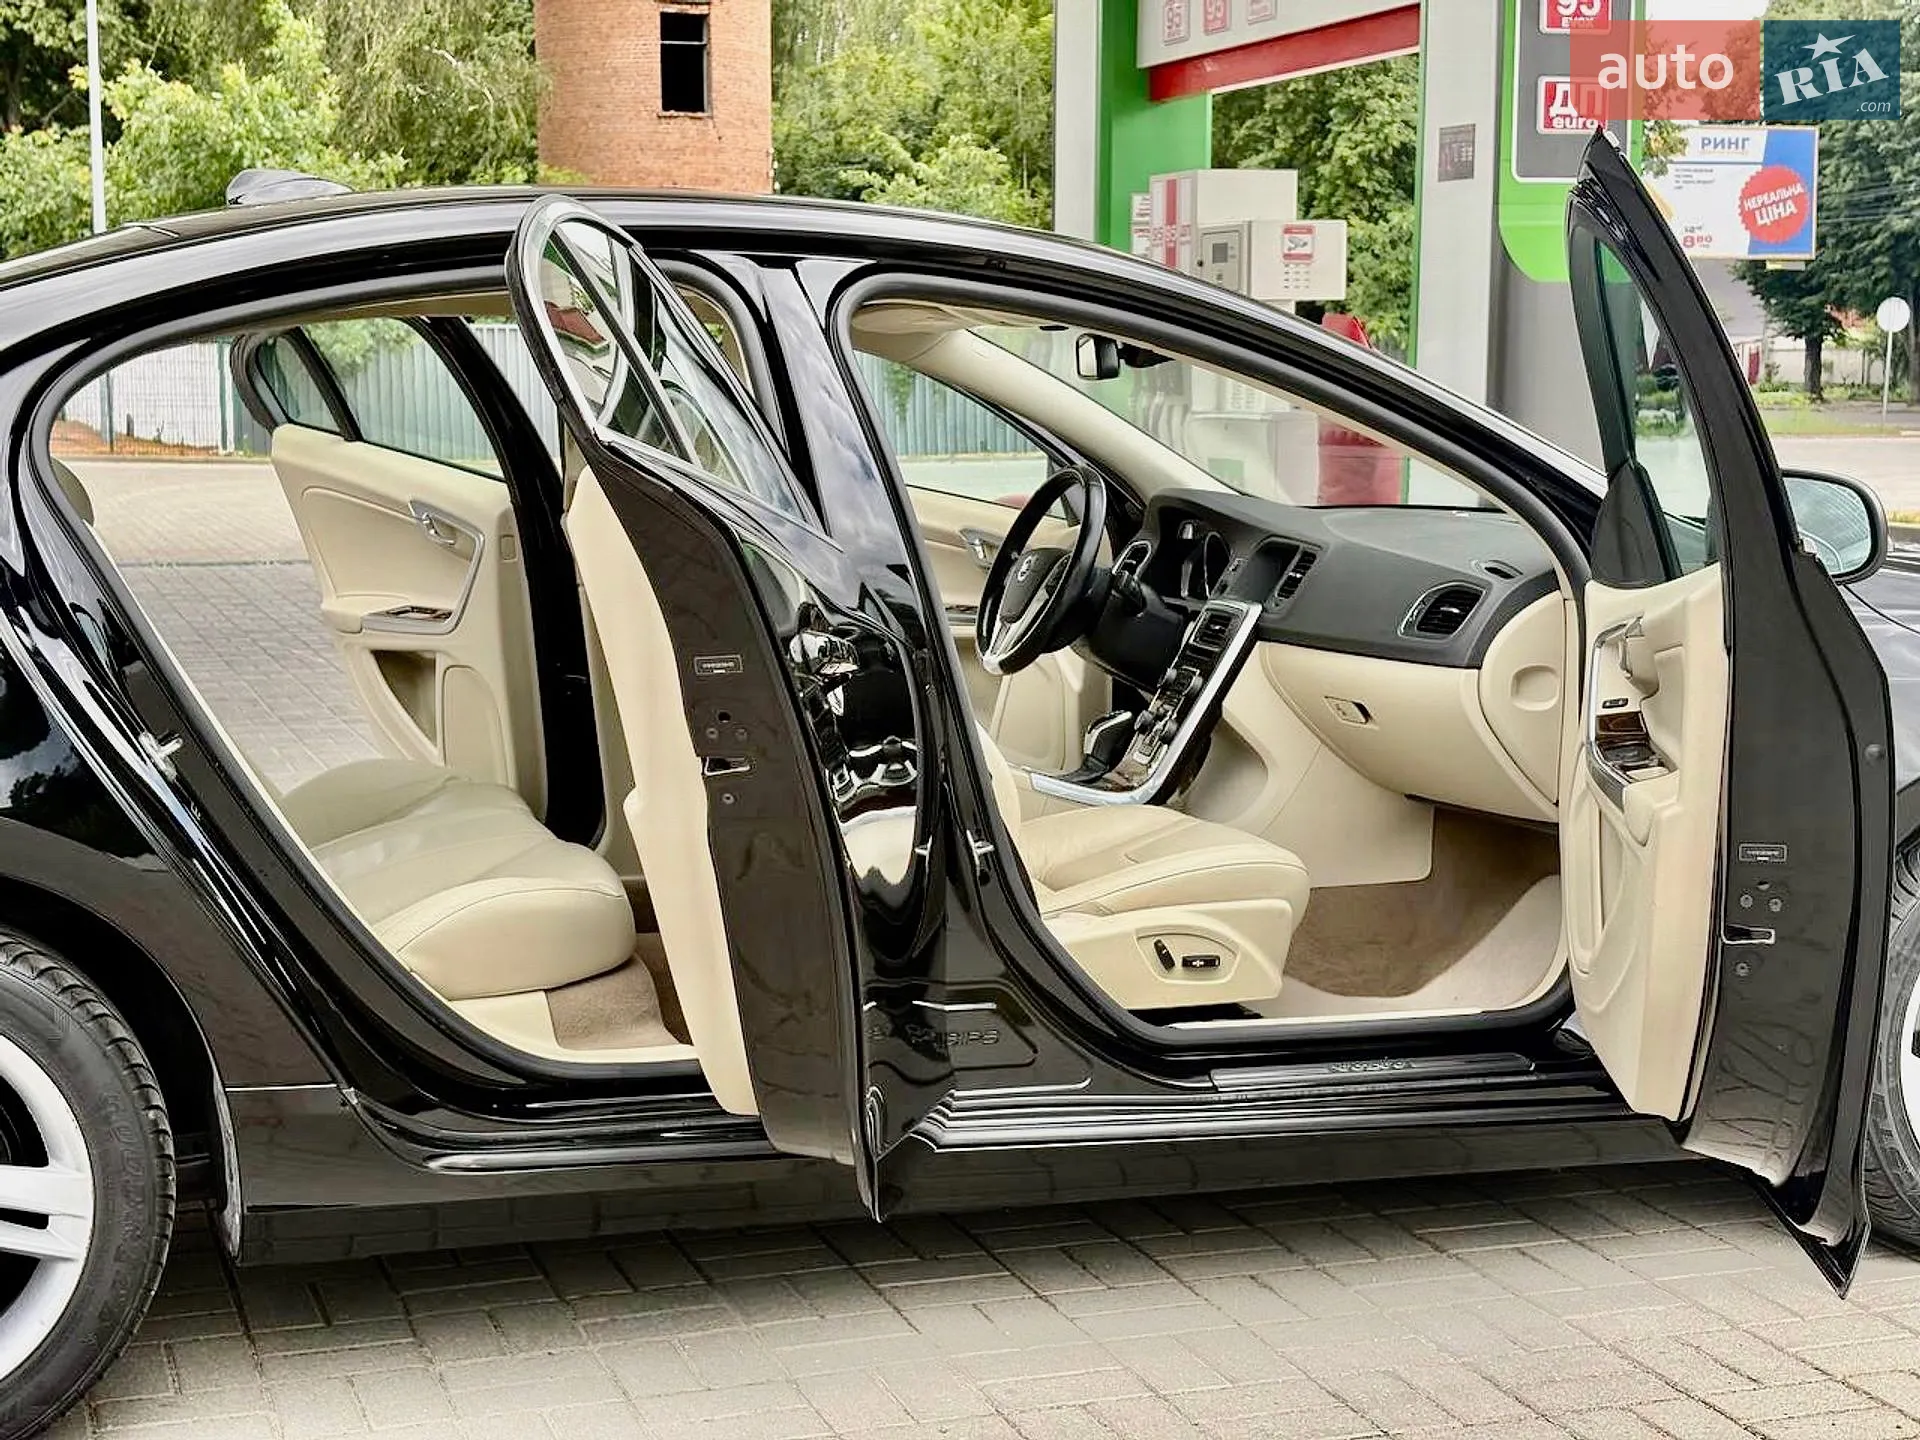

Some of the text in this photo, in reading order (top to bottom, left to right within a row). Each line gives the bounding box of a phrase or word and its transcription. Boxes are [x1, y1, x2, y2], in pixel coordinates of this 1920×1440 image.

[1553, 116, 1599, 129] euro
[1701, 137, 1751, 150] РИНГ
[1743, 182, 1805, 212] НЕРЕАЛЬНА
[1754, 199, 1799, 227] ЦІНА
